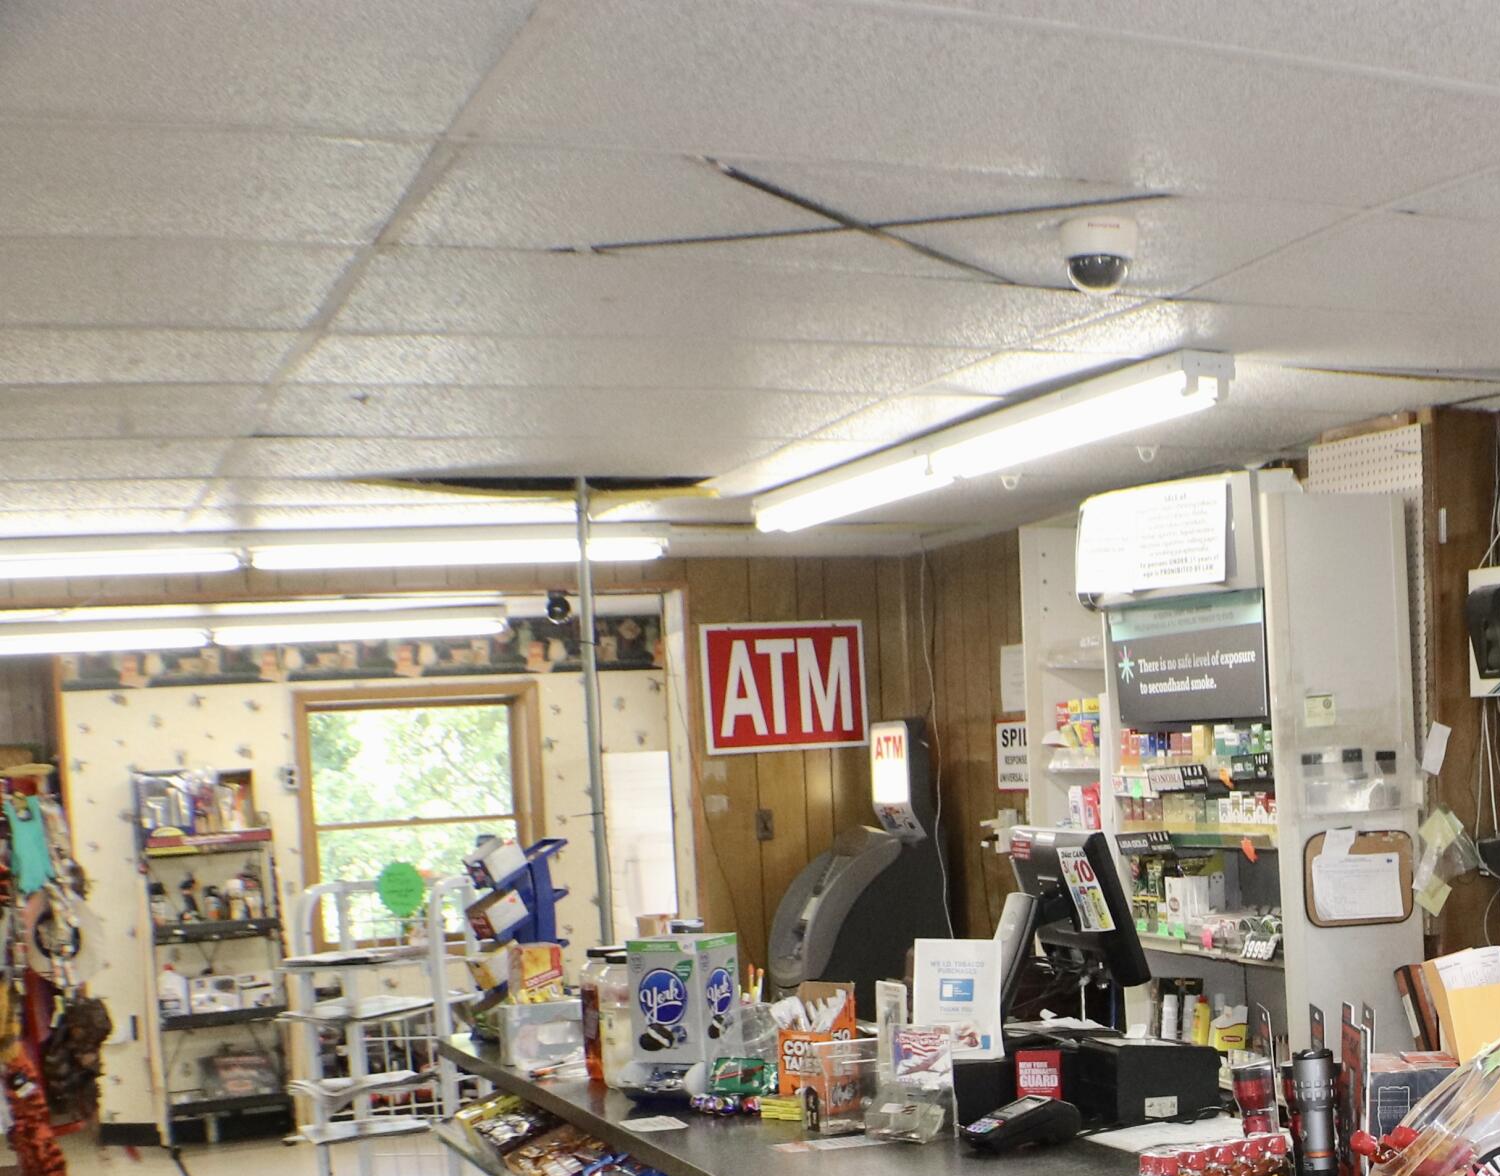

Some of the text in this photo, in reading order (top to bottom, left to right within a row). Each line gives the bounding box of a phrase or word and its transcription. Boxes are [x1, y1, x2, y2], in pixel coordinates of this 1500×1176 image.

[1138, 649, 1256, 673] There is no safe level of exposure
[721, 636, 854, 738] ATM
[1140, 674, 1217, 695] to secondhand smoke.
[875, 735, 904, 761] ATM
[1073, 860, 1095, 883] 10
[640, 978, 685, 1022] York
[707, 975, 732, 1012] York
[1019, 1074, 1059, 1088] GUARD
